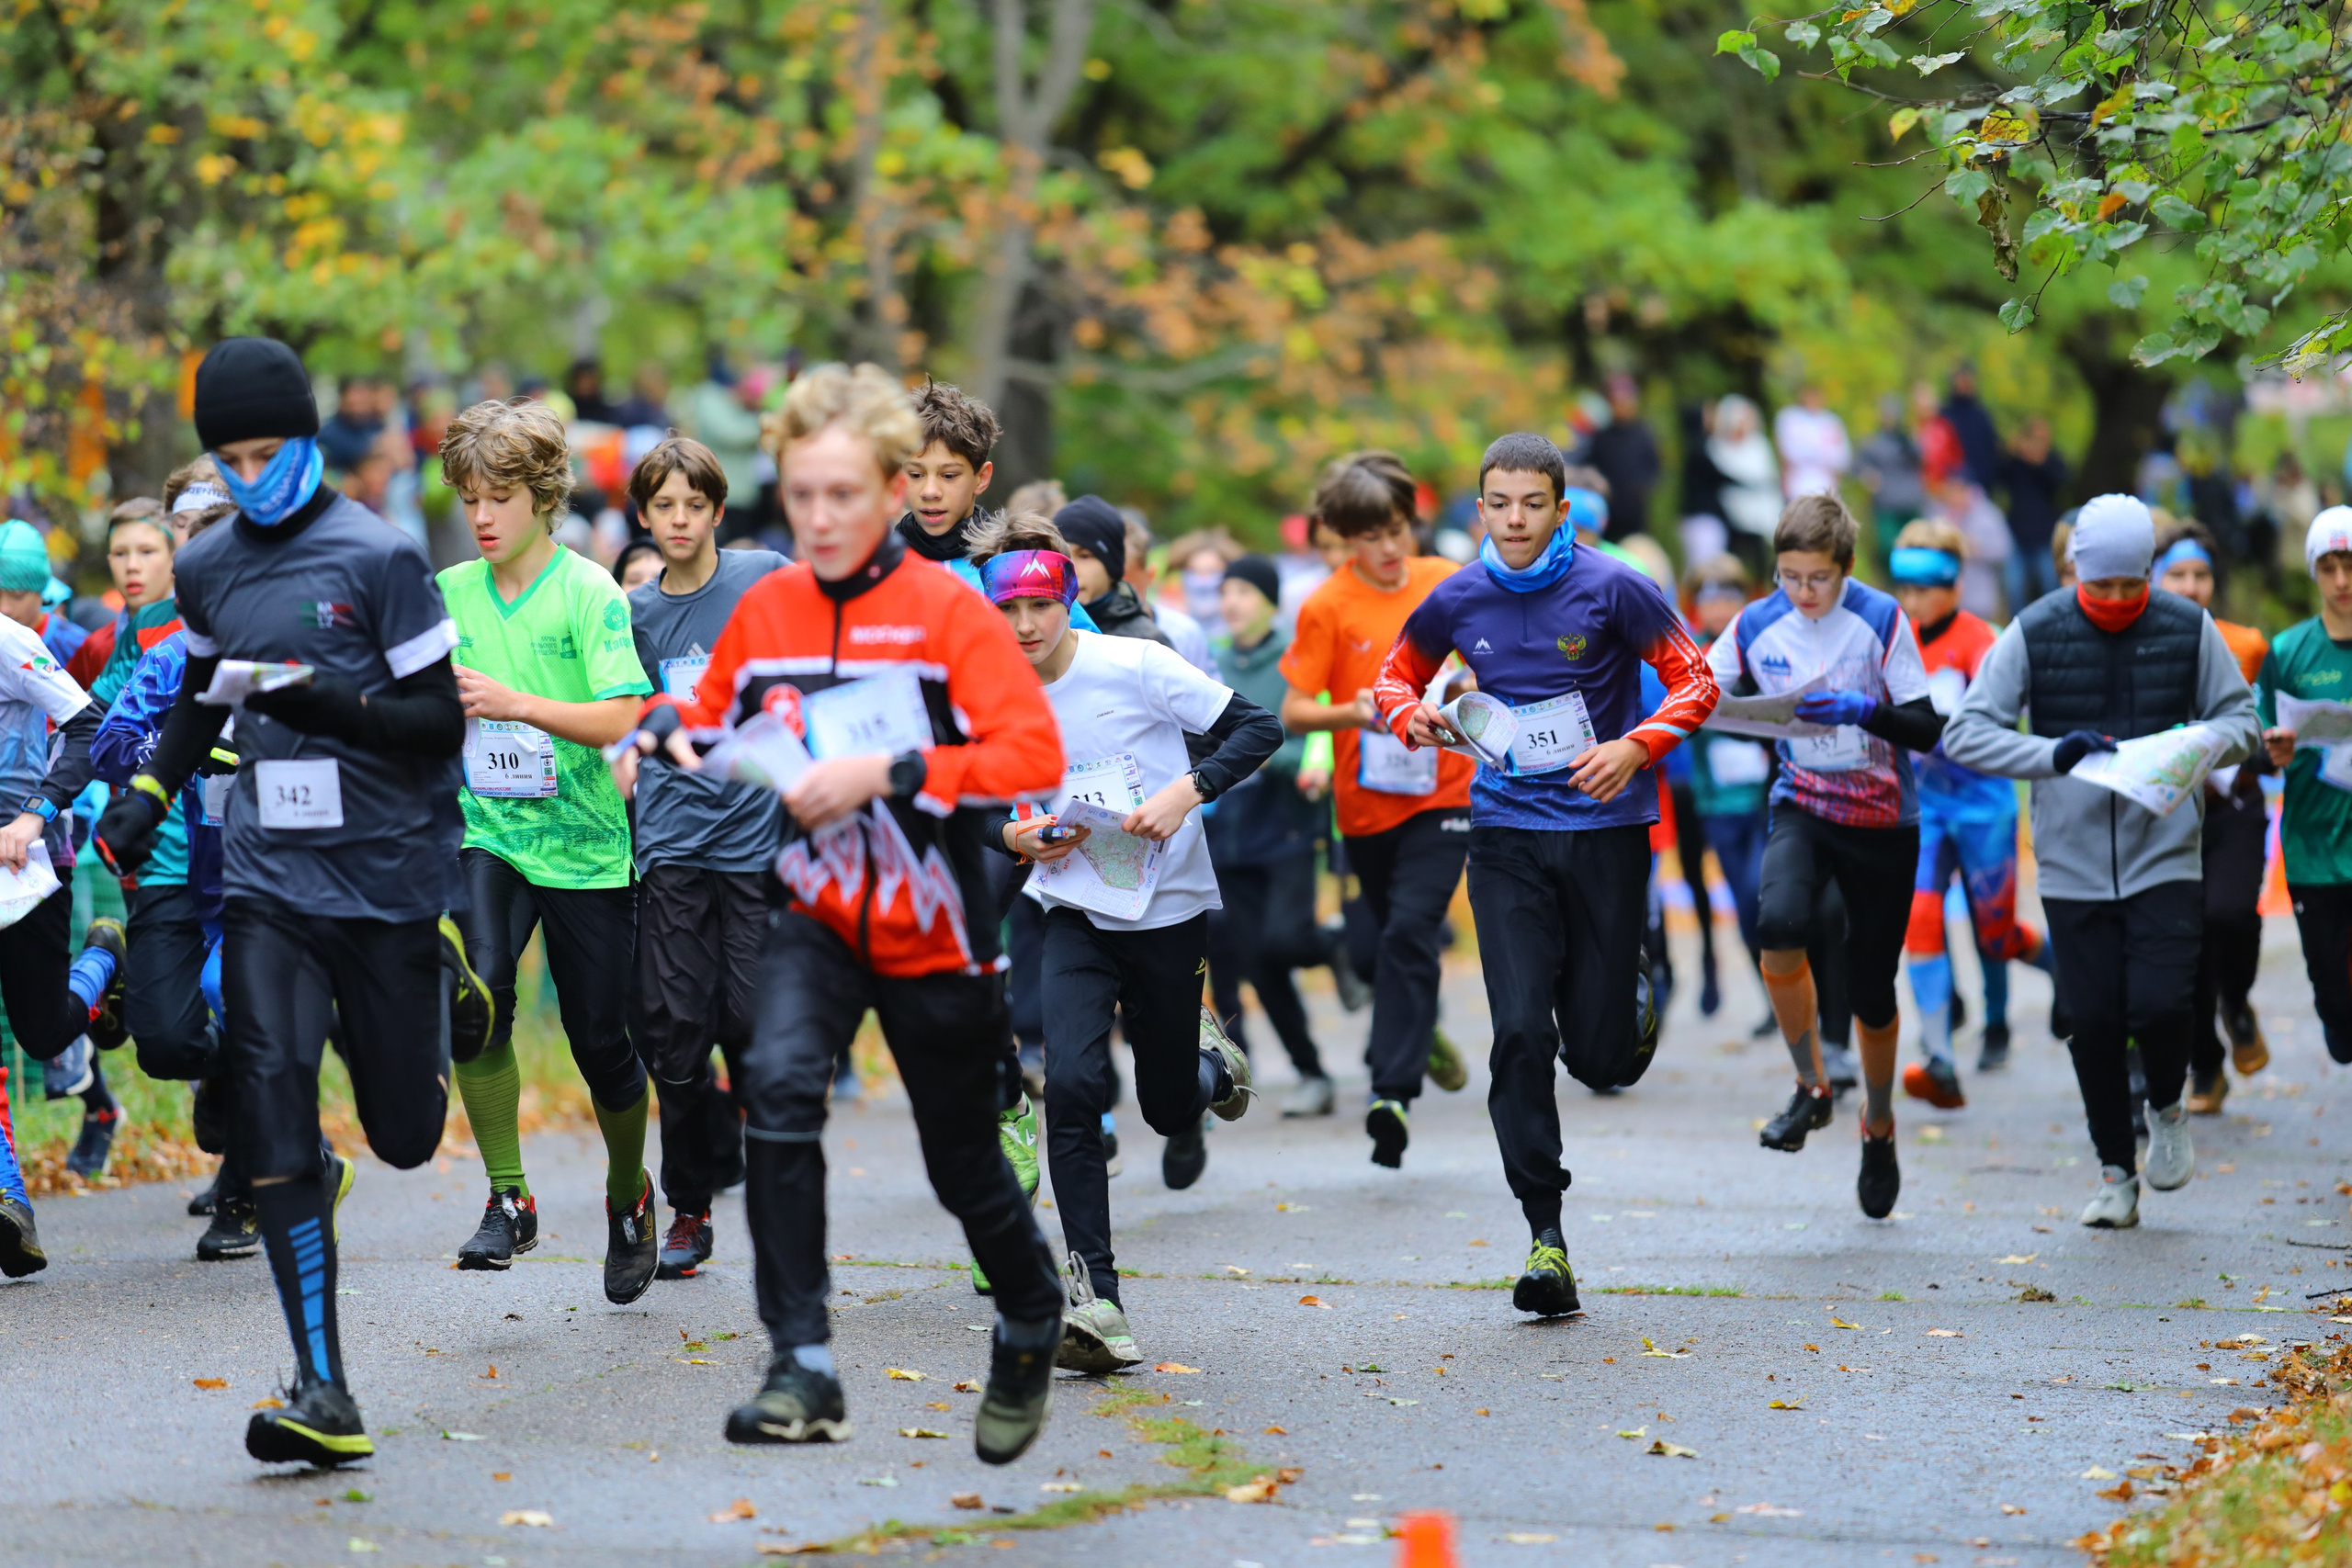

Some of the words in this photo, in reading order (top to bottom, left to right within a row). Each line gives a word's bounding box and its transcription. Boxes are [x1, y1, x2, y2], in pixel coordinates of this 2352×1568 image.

[1526, 729, 1559, 750] 351
[488, 752, 519, 770] 310
[276, 784, 311, 806] 342
